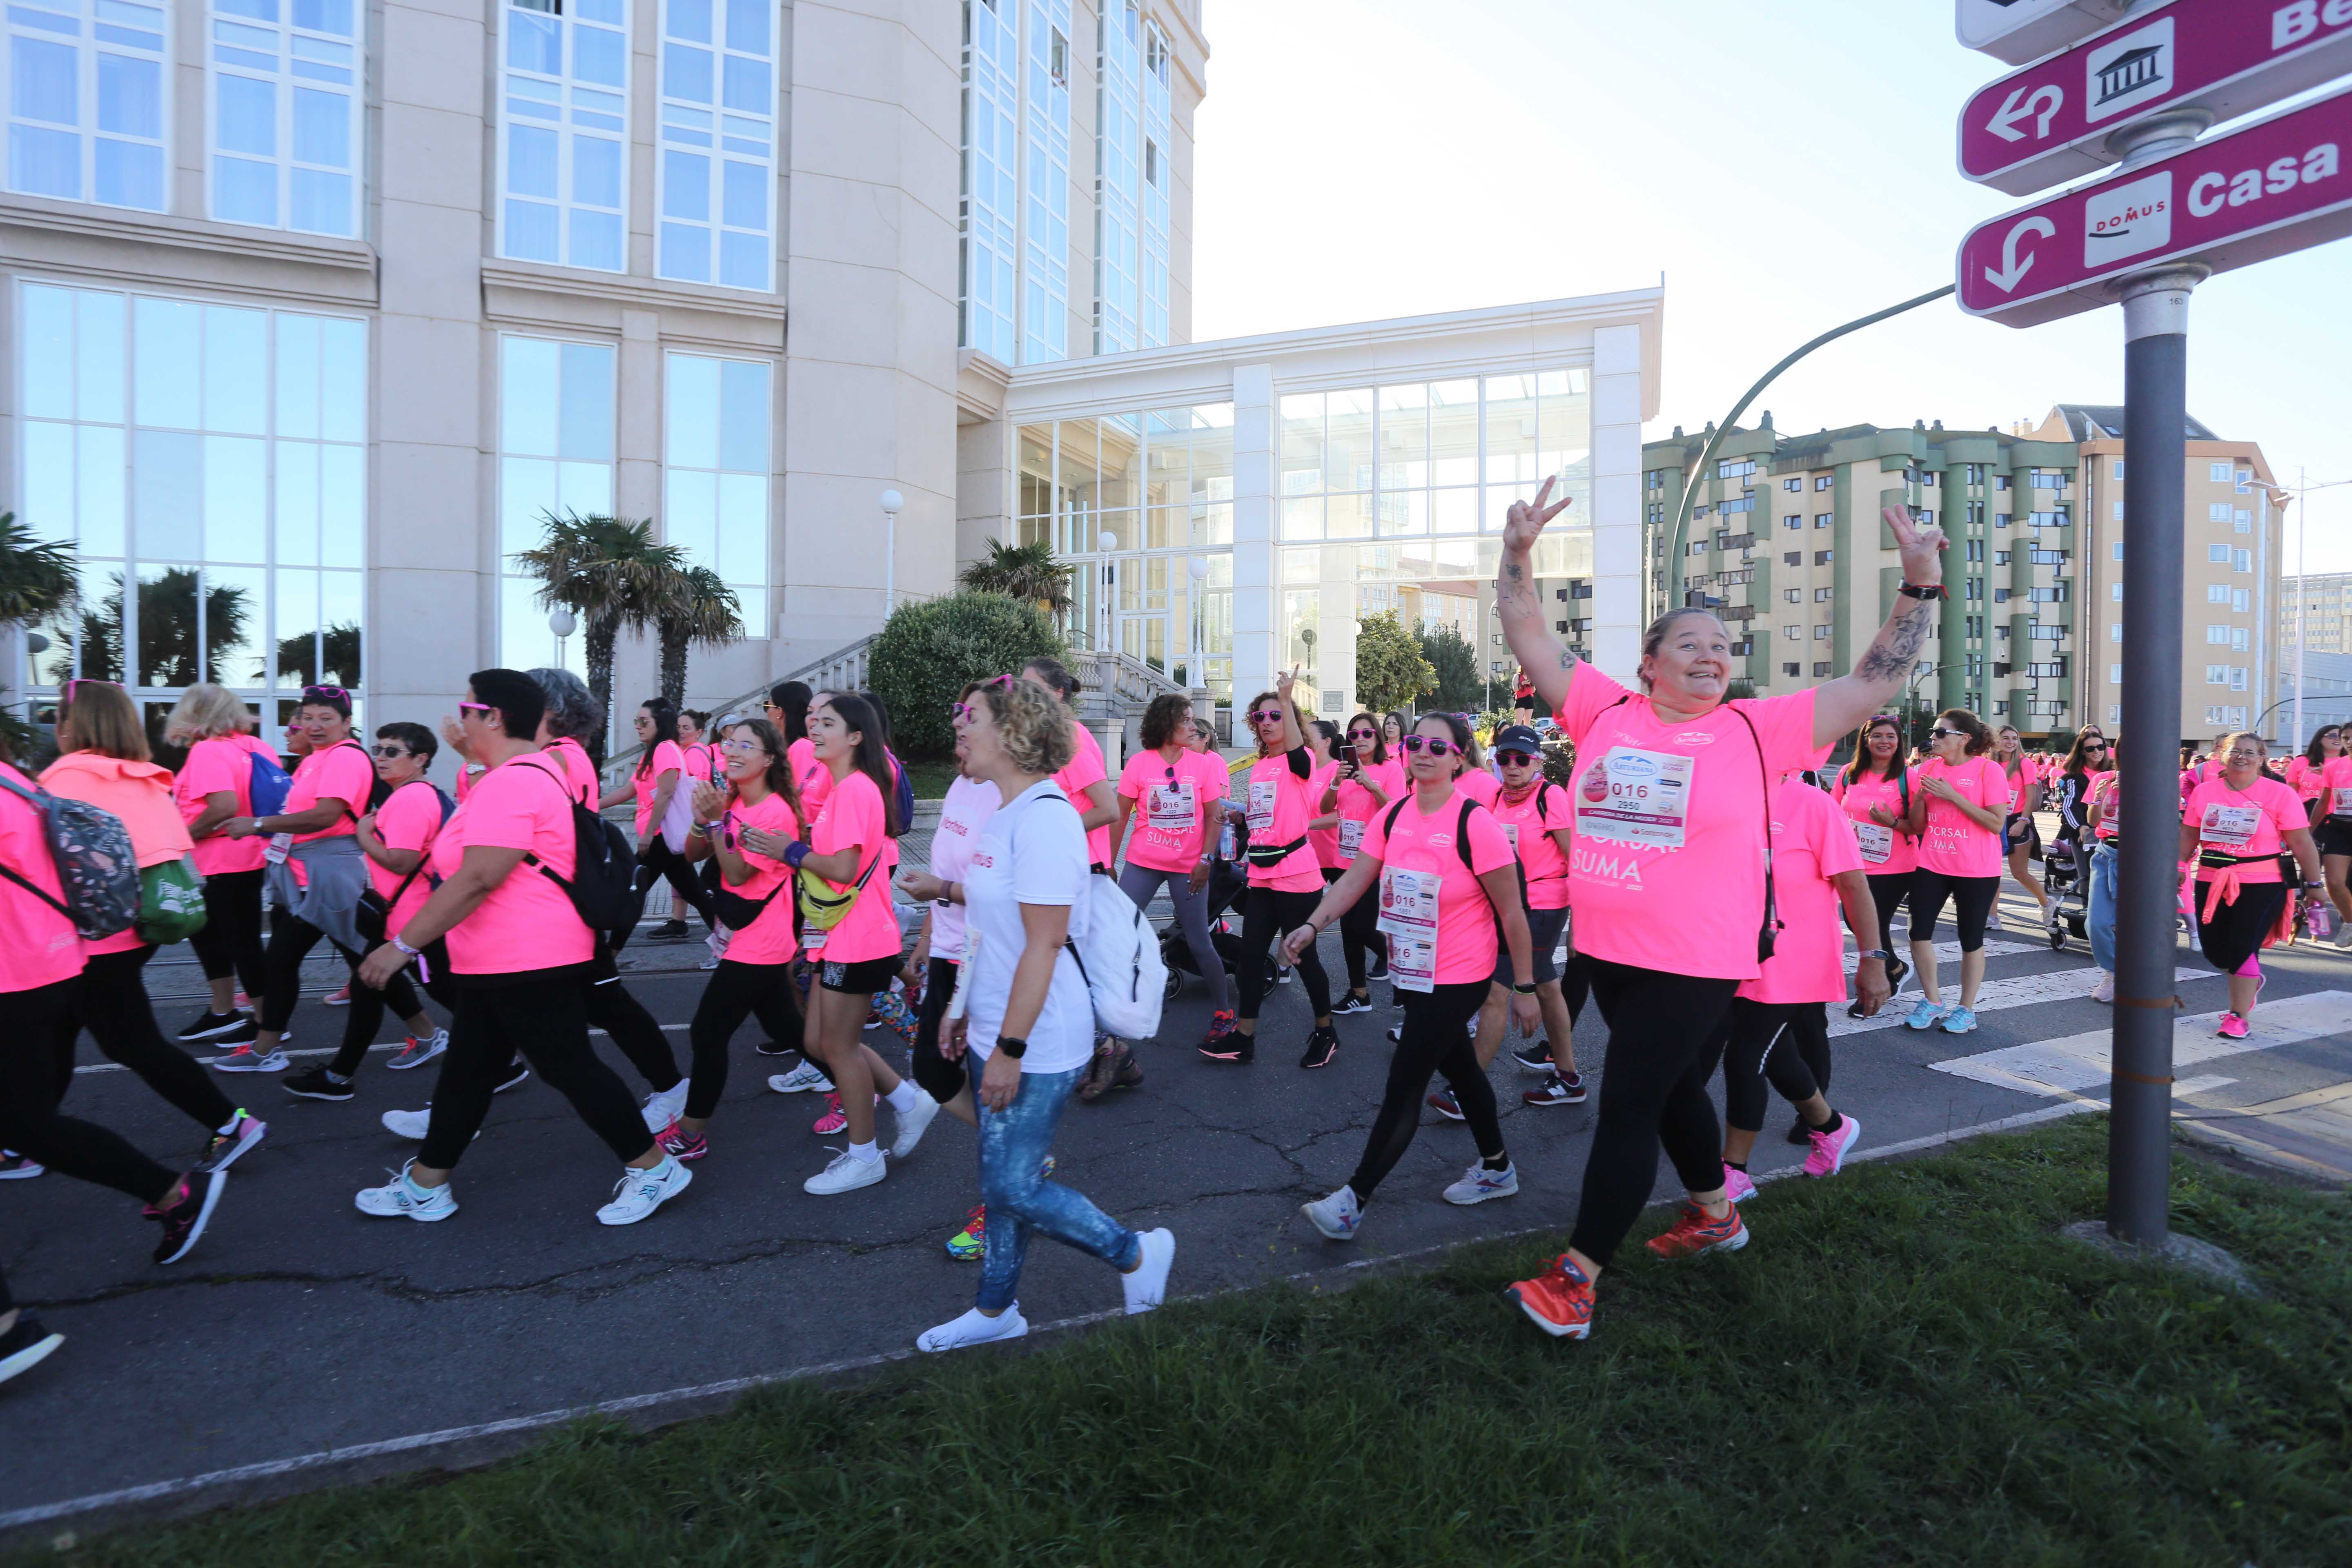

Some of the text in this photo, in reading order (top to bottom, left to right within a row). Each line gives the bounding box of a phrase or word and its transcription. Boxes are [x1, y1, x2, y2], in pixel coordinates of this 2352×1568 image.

[2187, 143, 2340, 218] Casa
[2097, 201, 2165, 232] DOMUS
[1613, 783, 1648, 798] 016
[1617, 801, 1640, 810] 2950
[1928, 812, 1937, 822] TU
[1147, 831, 1182, 848] SUMA
[1640, 829, 1675, 838] Santander
[1573, 849, 1642, 882] SUMA
[1396, 895, 1415, 906] 016
